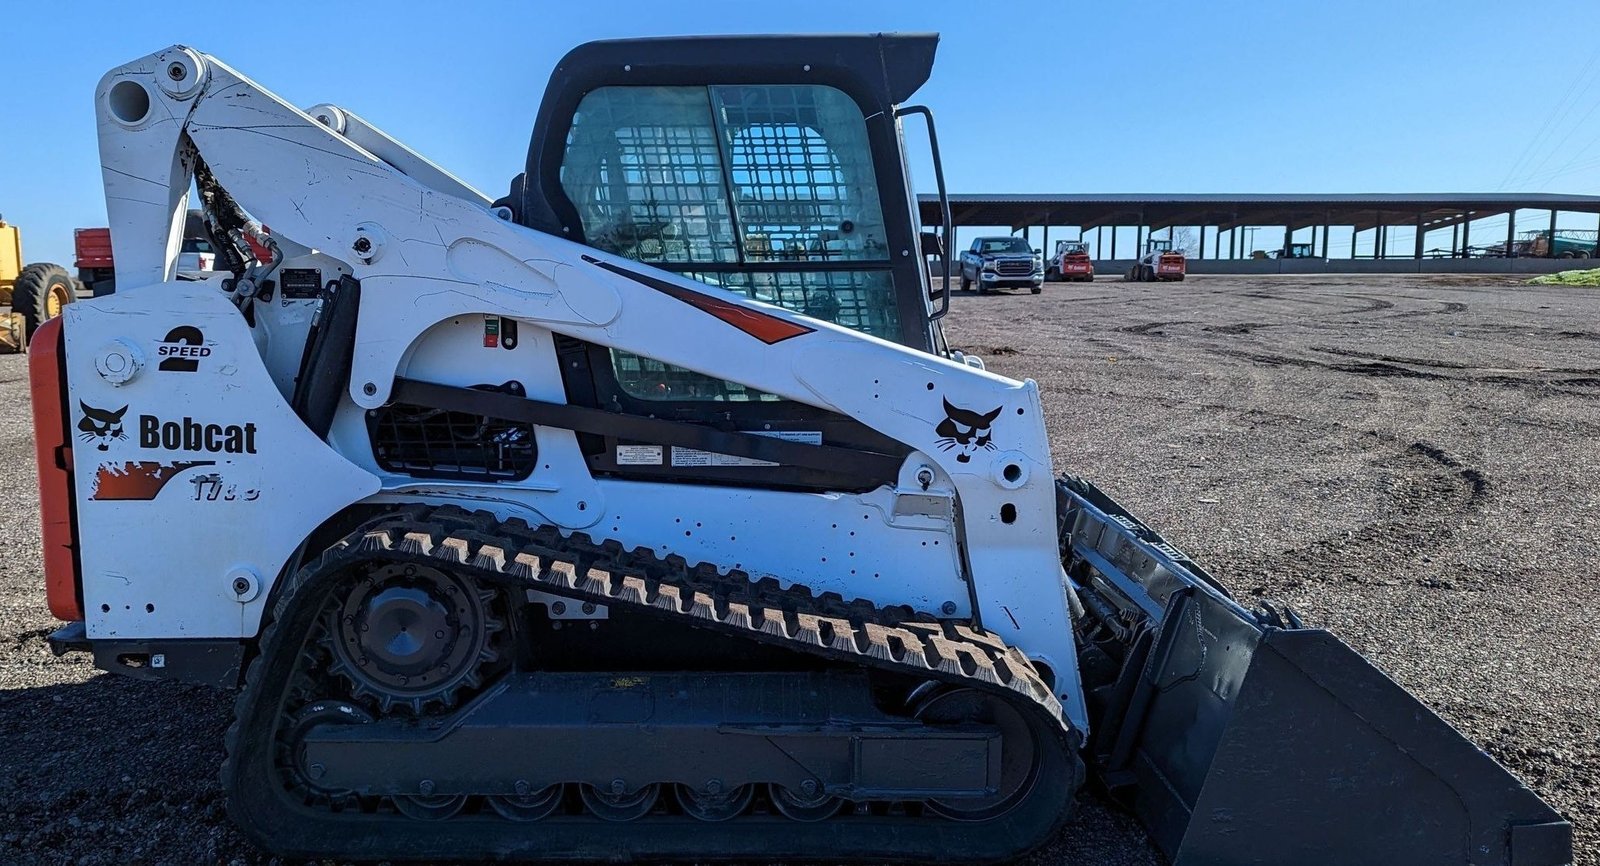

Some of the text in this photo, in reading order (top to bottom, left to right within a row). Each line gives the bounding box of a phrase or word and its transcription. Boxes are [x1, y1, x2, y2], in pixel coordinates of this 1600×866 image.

[158, 325, 203, 372] 2
[158, 346, 211, 357] SPEED
[140, 414, 257, 454] Bobcat
